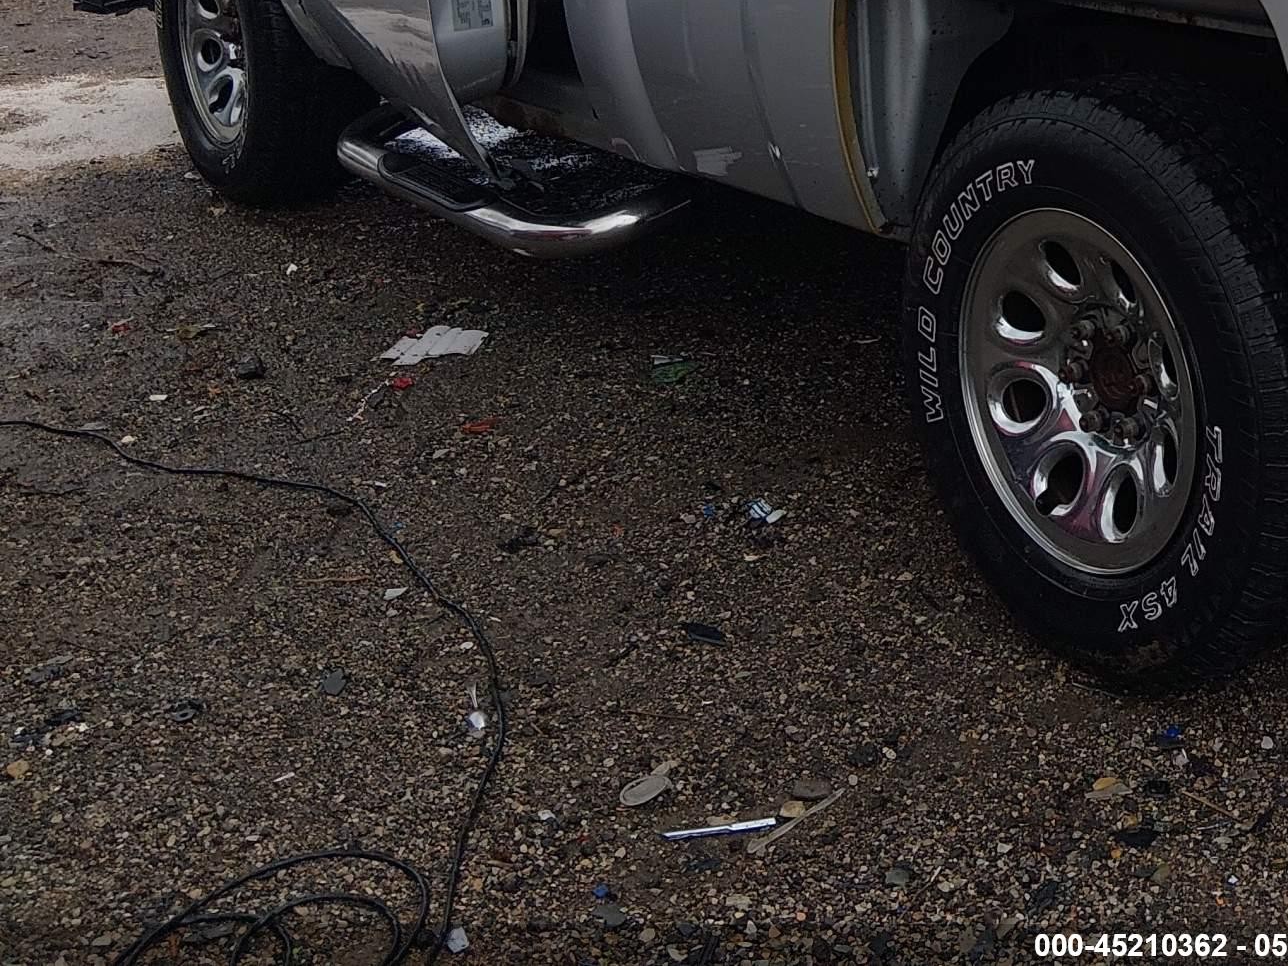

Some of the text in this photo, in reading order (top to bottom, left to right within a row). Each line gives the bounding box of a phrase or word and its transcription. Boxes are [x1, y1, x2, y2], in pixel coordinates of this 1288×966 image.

[917, 158, 1036, 423] WILD COUNTRY
[1117, 425, 1223, 632] TRAIL 4SX
